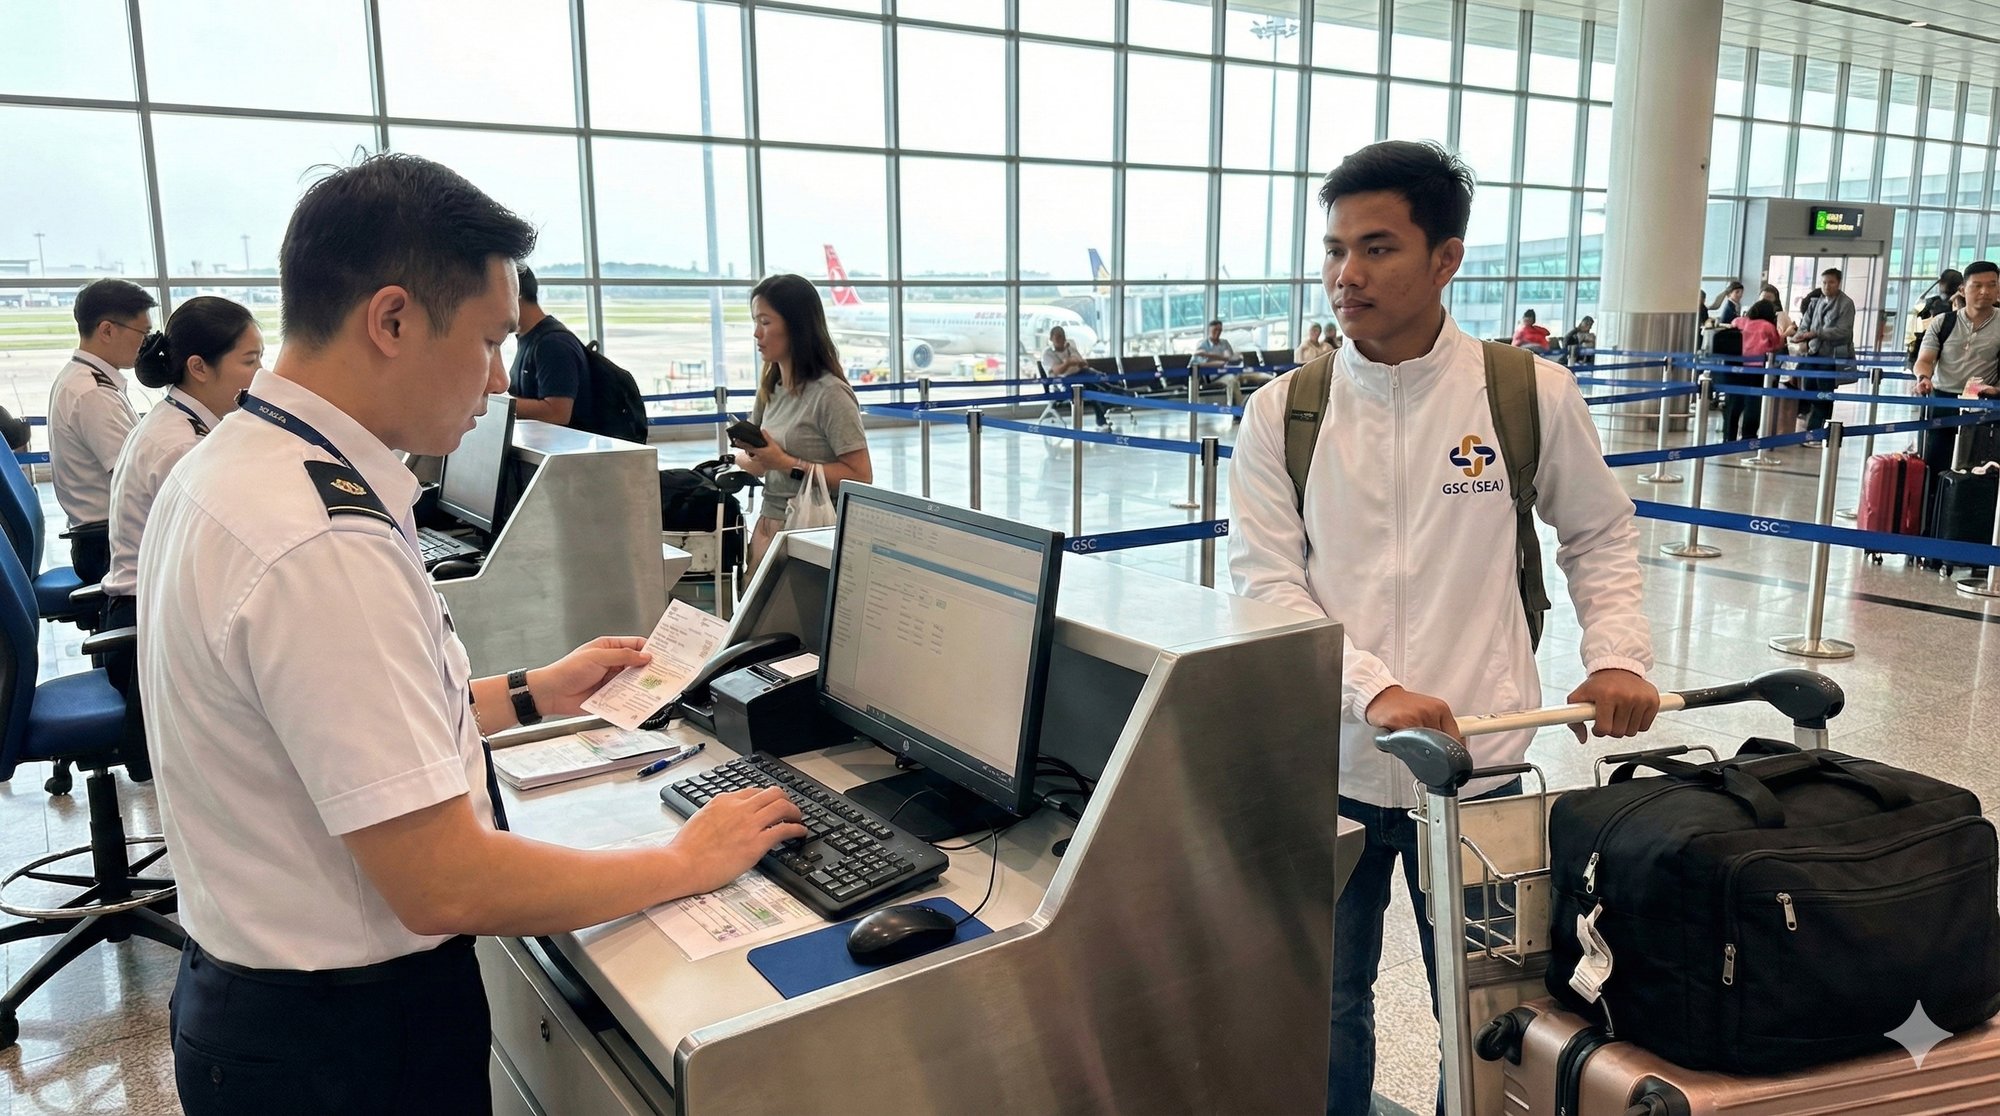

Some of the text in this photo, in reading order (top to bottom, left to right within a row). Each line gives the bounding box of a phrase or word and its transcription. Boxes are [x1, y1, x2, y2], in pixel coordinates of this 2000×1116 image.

[1442, 479, 1504, 495] GSC (SEA)
[1749, 519, 1780, 533] GSC
[1071, 538, 1097, 551] GSC
